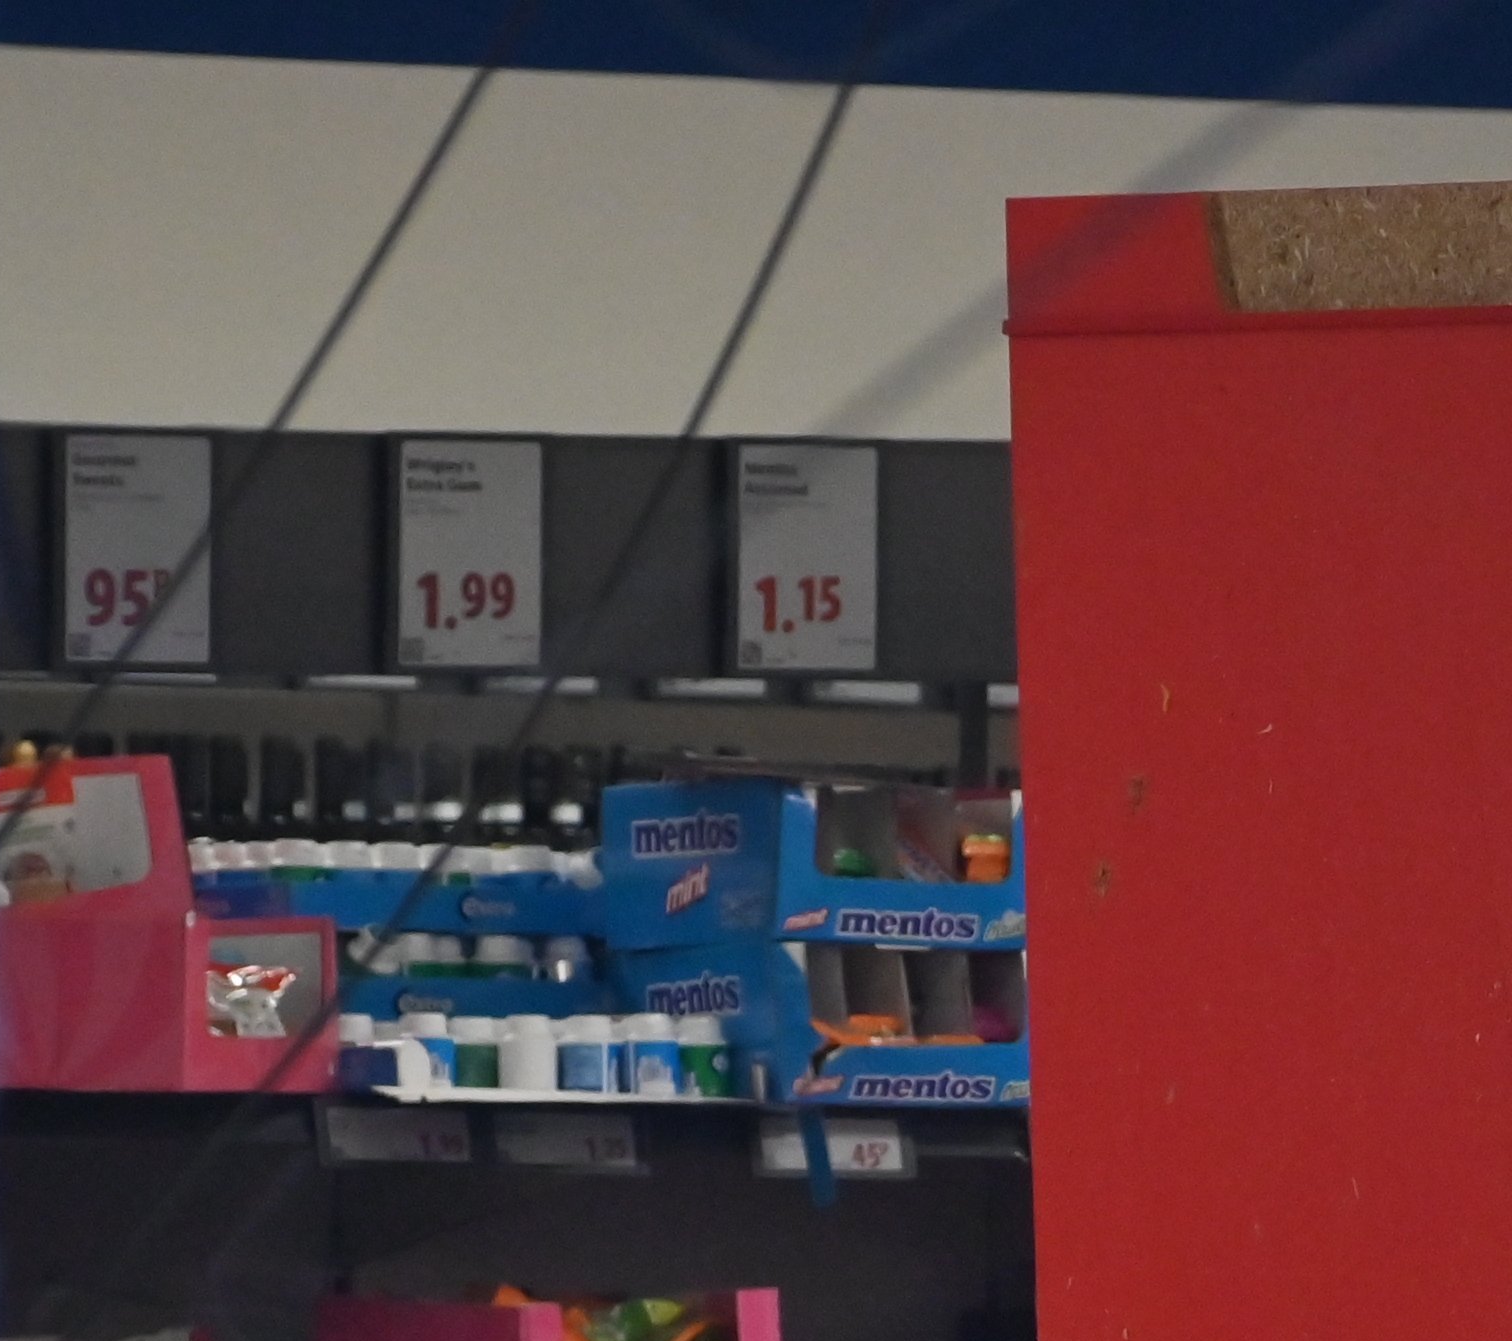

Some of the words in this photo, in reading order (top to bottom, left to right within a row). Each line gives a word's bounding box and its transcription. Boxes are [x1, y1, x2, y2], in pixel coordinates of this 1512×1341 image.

[416, 570, 516, 630] 1.99
[754, 574, 843, 633] 1.15
[633, 810, 741, 857] mentos
[836, 907, 979, 940] mentos
[646, 972, 741, 1015] mentos
[851, 1071, 996, 1100] mentos
